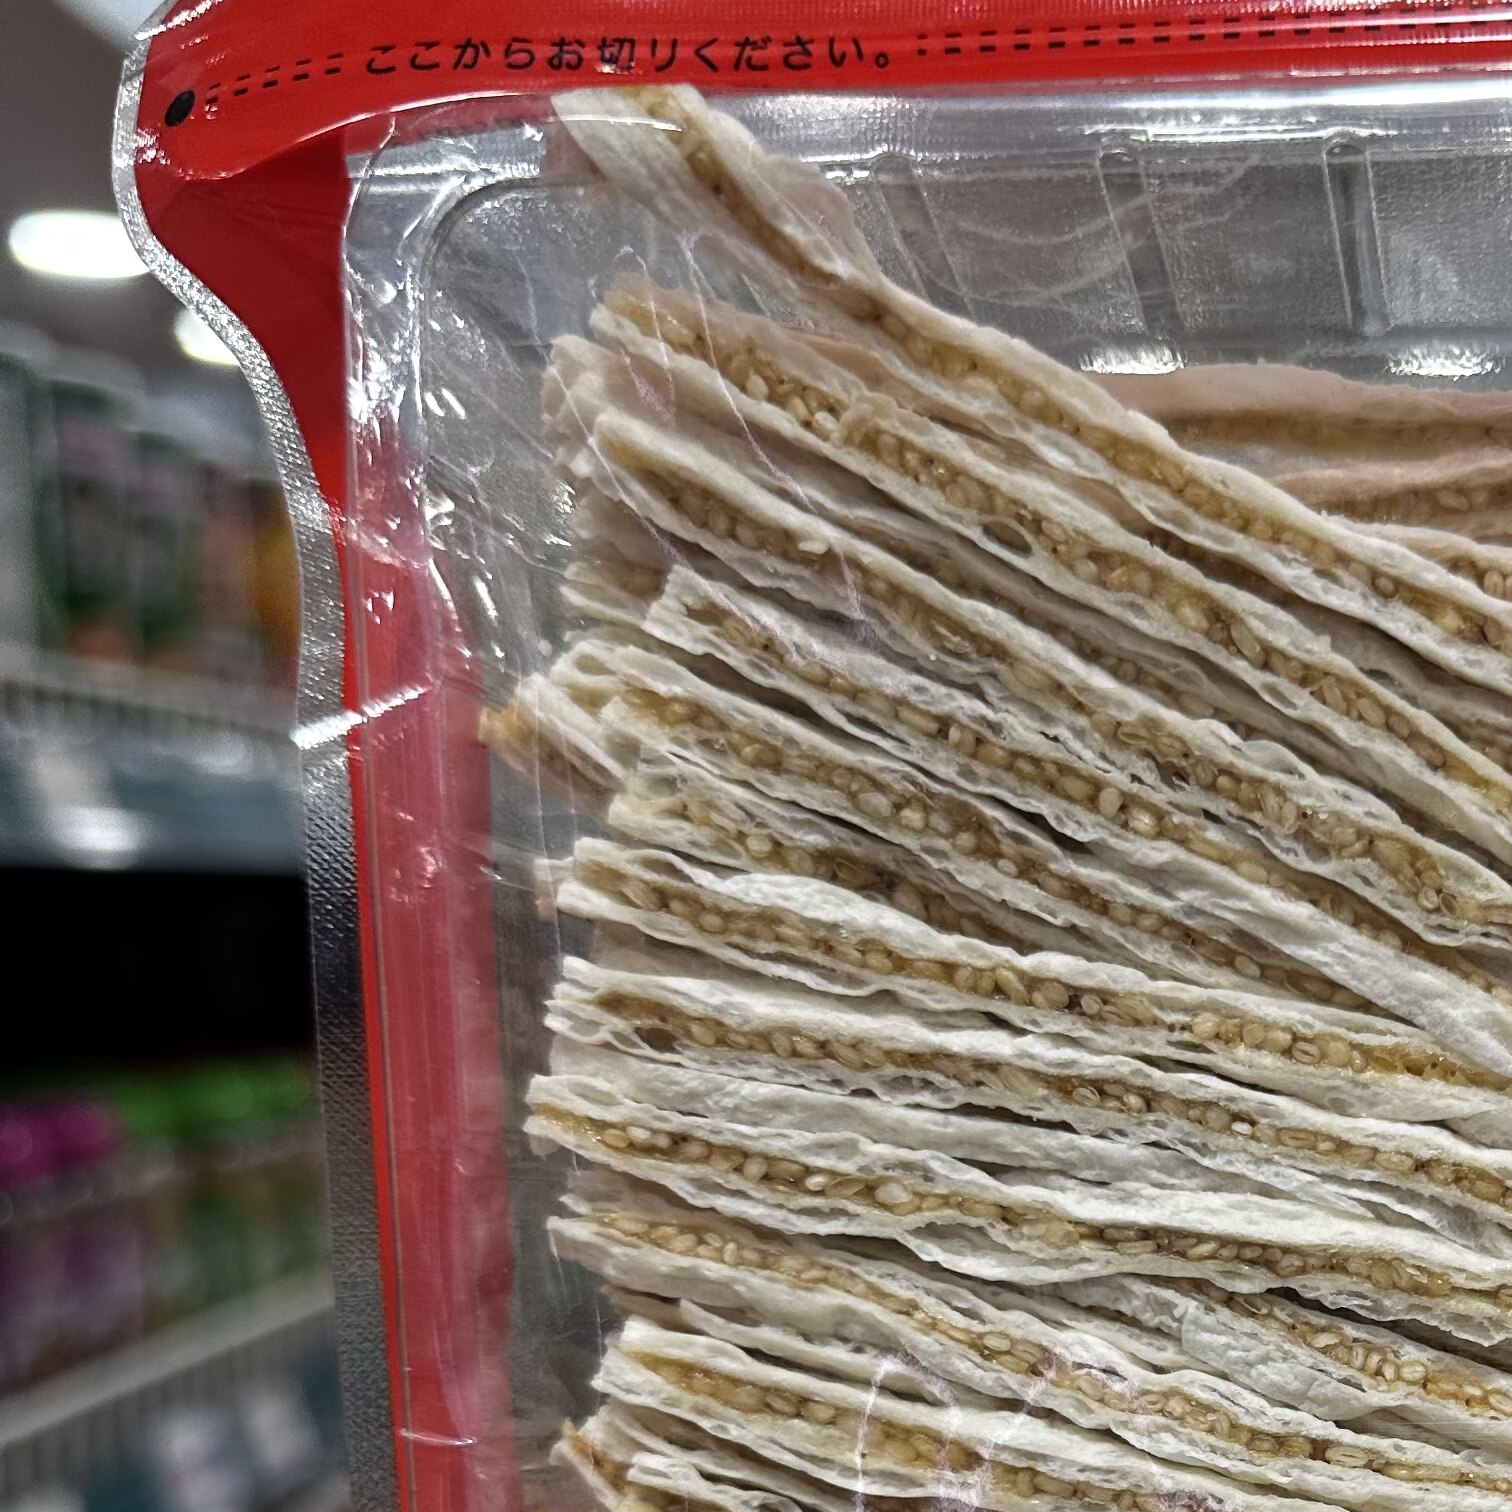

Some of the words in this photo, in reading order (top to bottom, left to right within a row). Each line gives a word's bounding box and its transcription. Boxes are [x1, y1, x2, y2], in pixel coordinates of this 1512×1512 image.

[366, 35, 891, 73] ここからお切りください。
